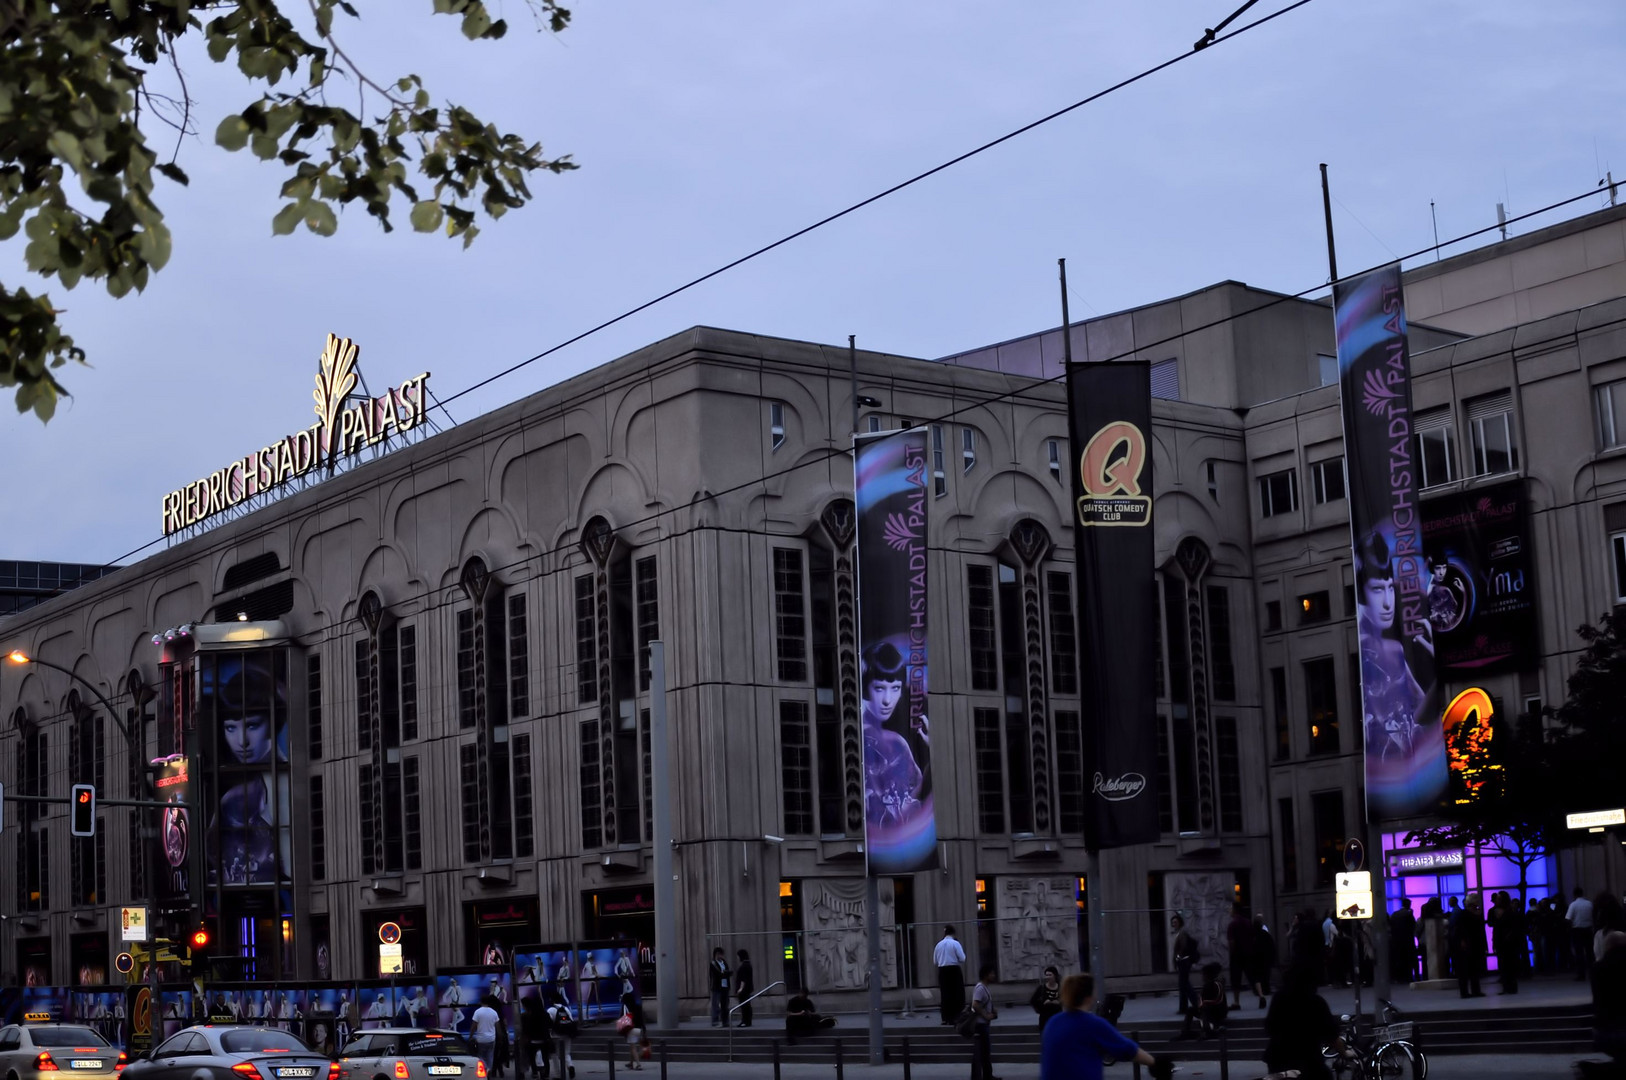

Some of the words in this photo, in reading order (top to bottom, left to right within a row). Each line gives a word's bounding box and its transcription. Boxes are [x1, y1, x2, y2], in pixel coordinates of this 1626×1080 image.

[1382, 286, 1406, 385] PALAST
[162, 420, 323, 535] FRIEDRICHSTADT
[341, 372, 430, 455] PALAST
[905, 444, 925, 527] PALAST
[1080, 420, 1146, 497] Q
[1084, 503, 1113, 513] QUATSCH
[1114, 504, 1145, 512] COMEDY
[1103, 512, 1121, 520] CLUB
[1389, 405, 1424, 637] FRIEDRICHSTADT
[1480, 567, 1525, 597] Yma
[908, 543, 927, 729] FRIEDRICHSTADT
